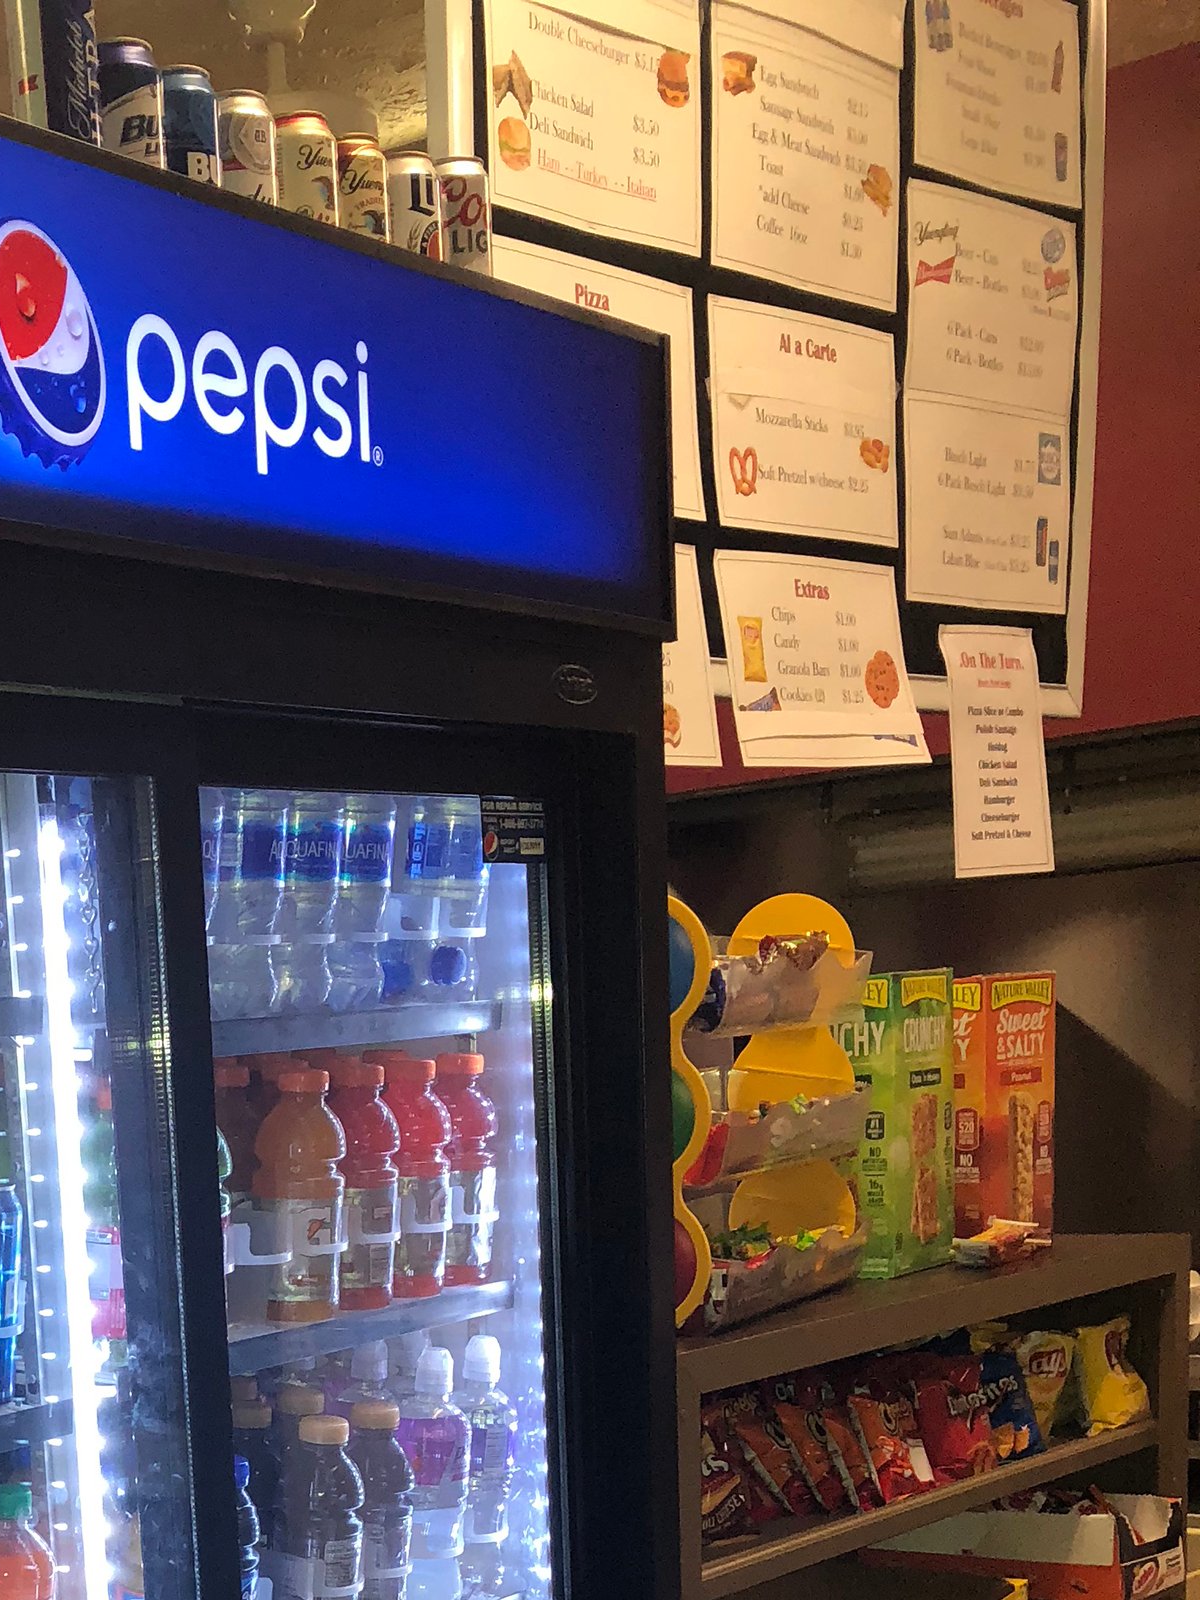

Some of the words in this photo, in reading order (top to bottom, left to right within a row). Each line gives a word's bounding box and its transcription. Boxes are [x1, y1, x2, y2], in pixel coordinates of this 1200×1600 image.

[529, 11, 564, 42] Double
[568, 26, 629, 66] Cheeseburger
[760, 65, 777, 88] Egg
[530, 79, 568, 109] Chicken
[571, 96, 594, 117] Salad
[633, 115, 659, 137] $3.50
[530, 113, 549, 135] Deli
[552, 121, 594, 151] Sandwich
[633, 147, 660, 168] $3.50
[752, 122, 769, 146] Egg
[759, 155, 784, 176] Toast
[627, 176, 657, 199] Italian
[781, 192, 810, 215] Cheese
[757, 214, 784, 237] Coffee
[575, 283, 610, 311] Pizza
[780, 333, 791, 354] Al
[795, 341, 803, 355] a
[806, 338, 837, 363] Carte
[126, 313, 371, 475] pepsi
[755, 407, 803, 430] Mozzarella
[805, 416, 829, 433] Sticks
[758, 465, 775, 482] Soft
[778, 466, 807, 485] Pretzel
[794, 578, 830, 601] Extras
[771, 606, 796, 623] Chips
[774, 633, 800, 652] Candy
[777, 663, 810, 676] Granola
[813, 662, 830, 677] Bars
[979, 652, 997, 669] The
[779, 687, 813, 703] Cookies
[968, 706, 983, 716] Pizza
[984, 706, 996, 716] Slice
[979, 759, 1001, 769] Chicken
[994, 982, 1023, 1002] NATURE
[1025, 980, 1051, 1000] VALLEY
[998, 1008, 1049, 1034] Sweet
[903, 1015, 946, 1053] CRUNCHY
[1006, 1032, 1045, 1060] SALTY
[960, 1154, 973, 1166] NO
